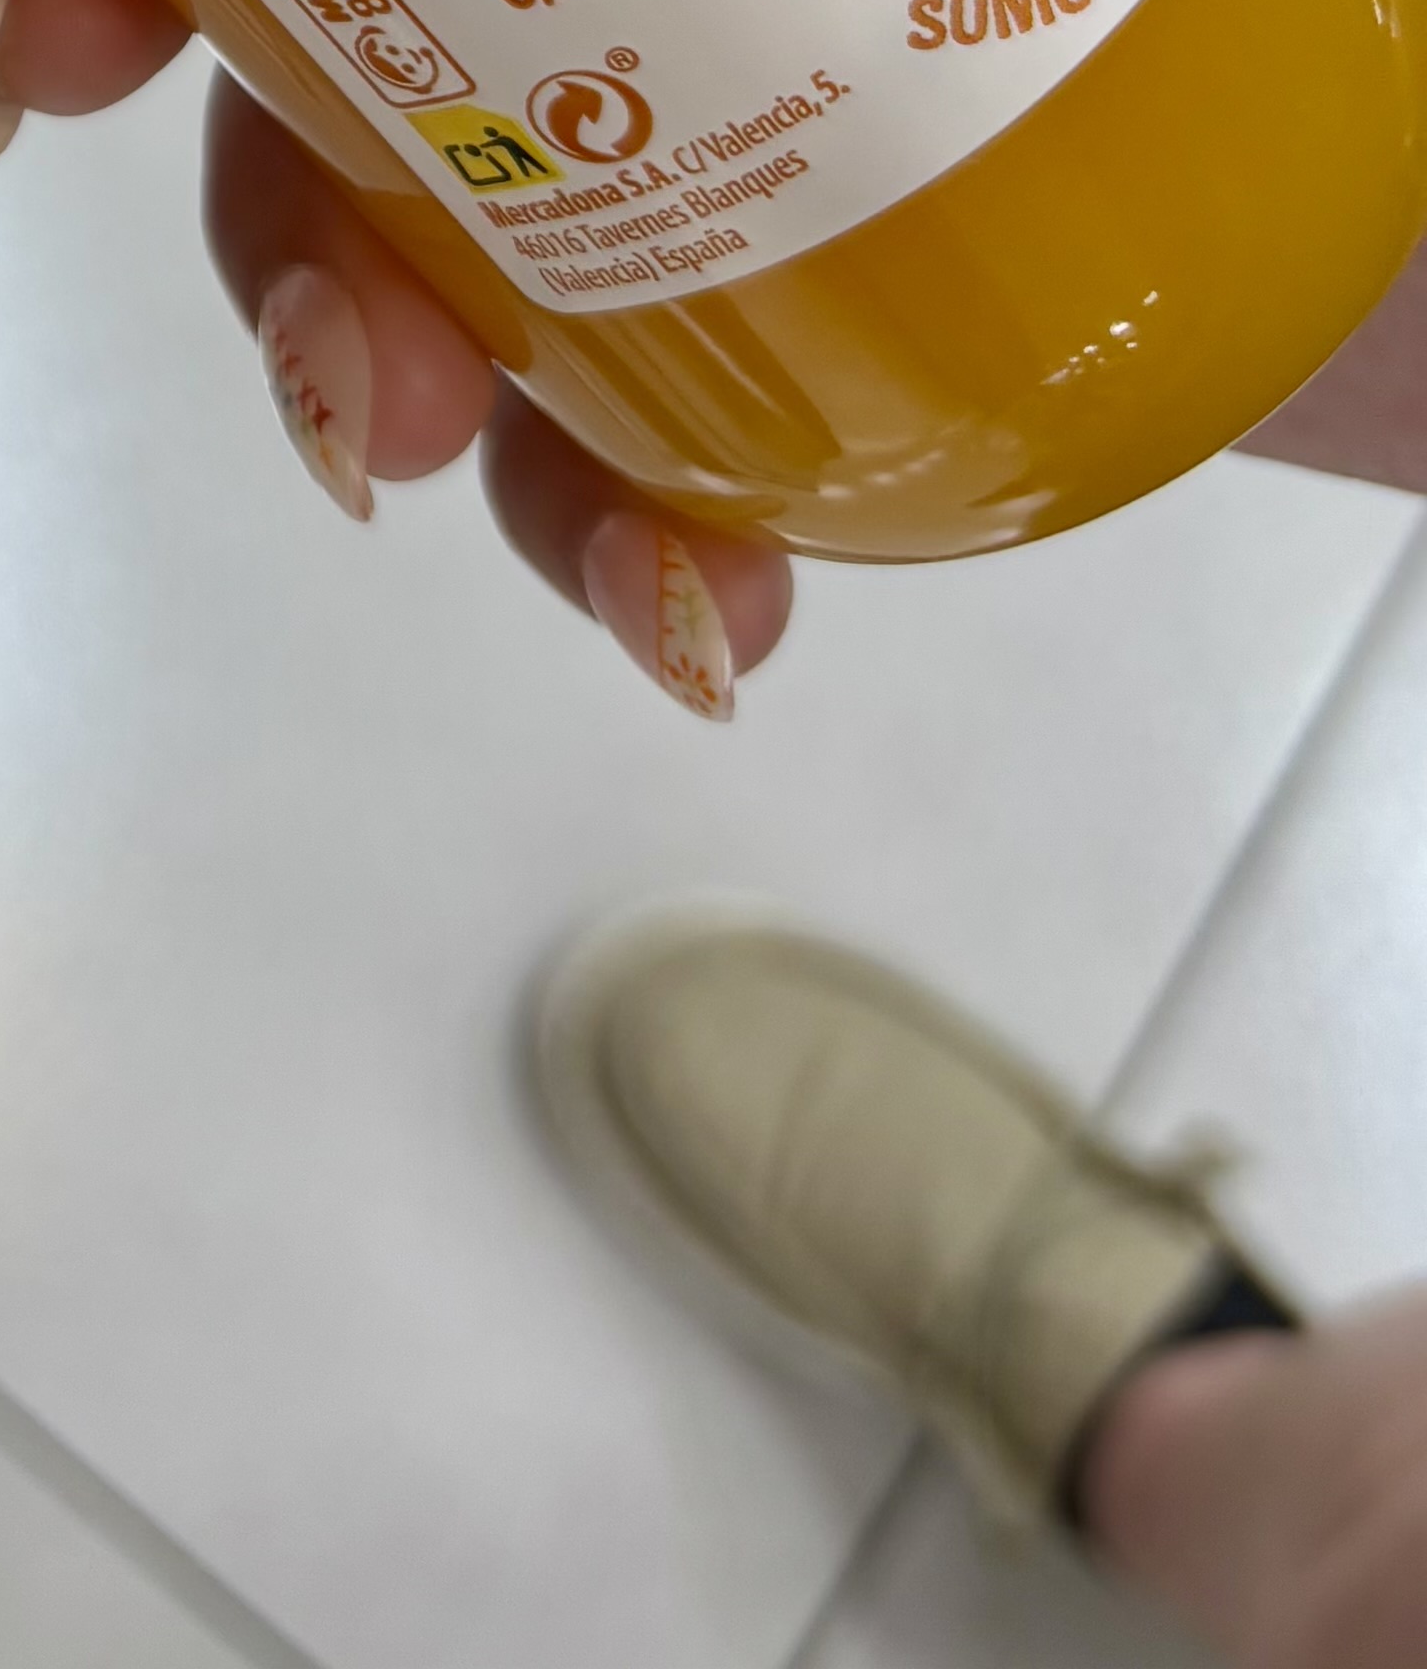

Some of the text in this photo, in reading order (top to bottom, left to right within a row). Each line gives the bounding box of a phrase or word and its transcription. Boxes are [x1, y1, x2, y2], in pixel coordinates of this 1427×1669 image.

[476, 180, 624, 230] Mercadona
[615, 160, 682, 199] S.A.
[809, 68, 852, 105] 5.
[511, 148, 812, 262] 46016 Tavernes Blanques
[538, 223, 750, 298] (Valencia) España
